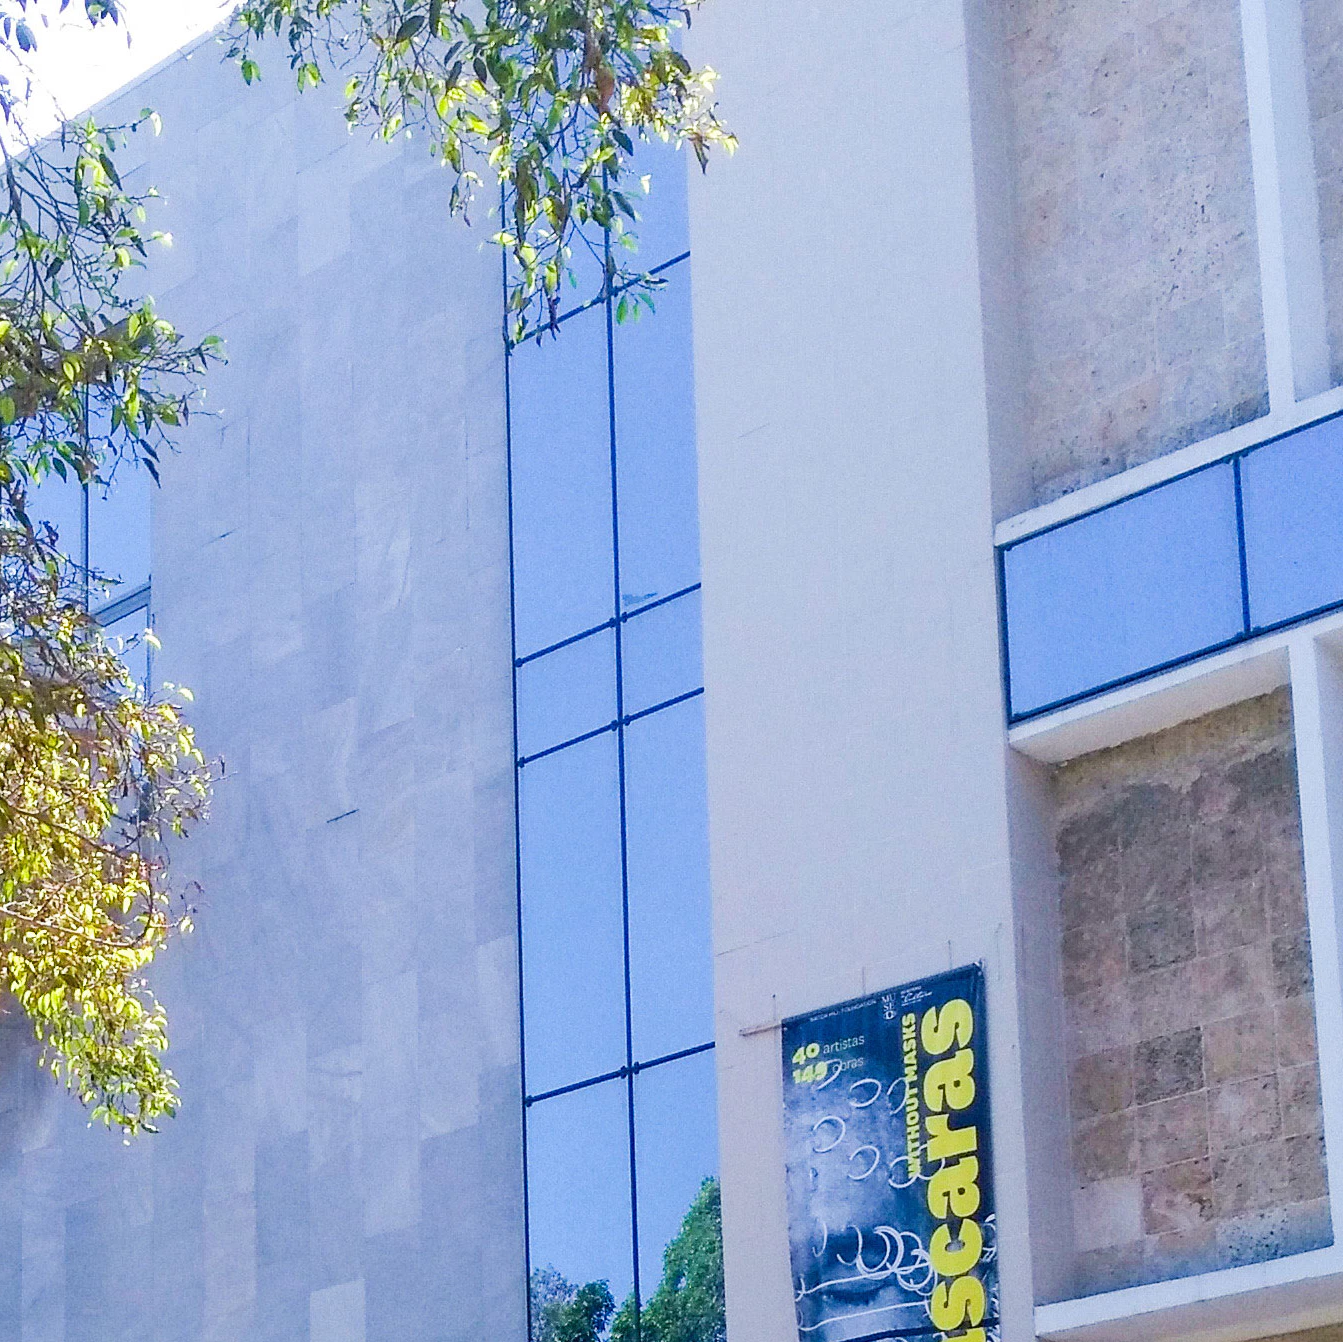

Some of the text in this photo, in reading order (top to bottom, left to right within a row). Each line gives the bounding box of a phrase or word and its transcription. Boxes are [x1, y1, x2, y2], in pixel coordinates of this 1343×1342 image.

[792, 1035, 866, 1065] 40 artistas
[792, 1056, 864, 1085] 149 obras
[901, 1012, 918, 1082] MASKS
[905, 1086, 921, 1178] WITHOUT
